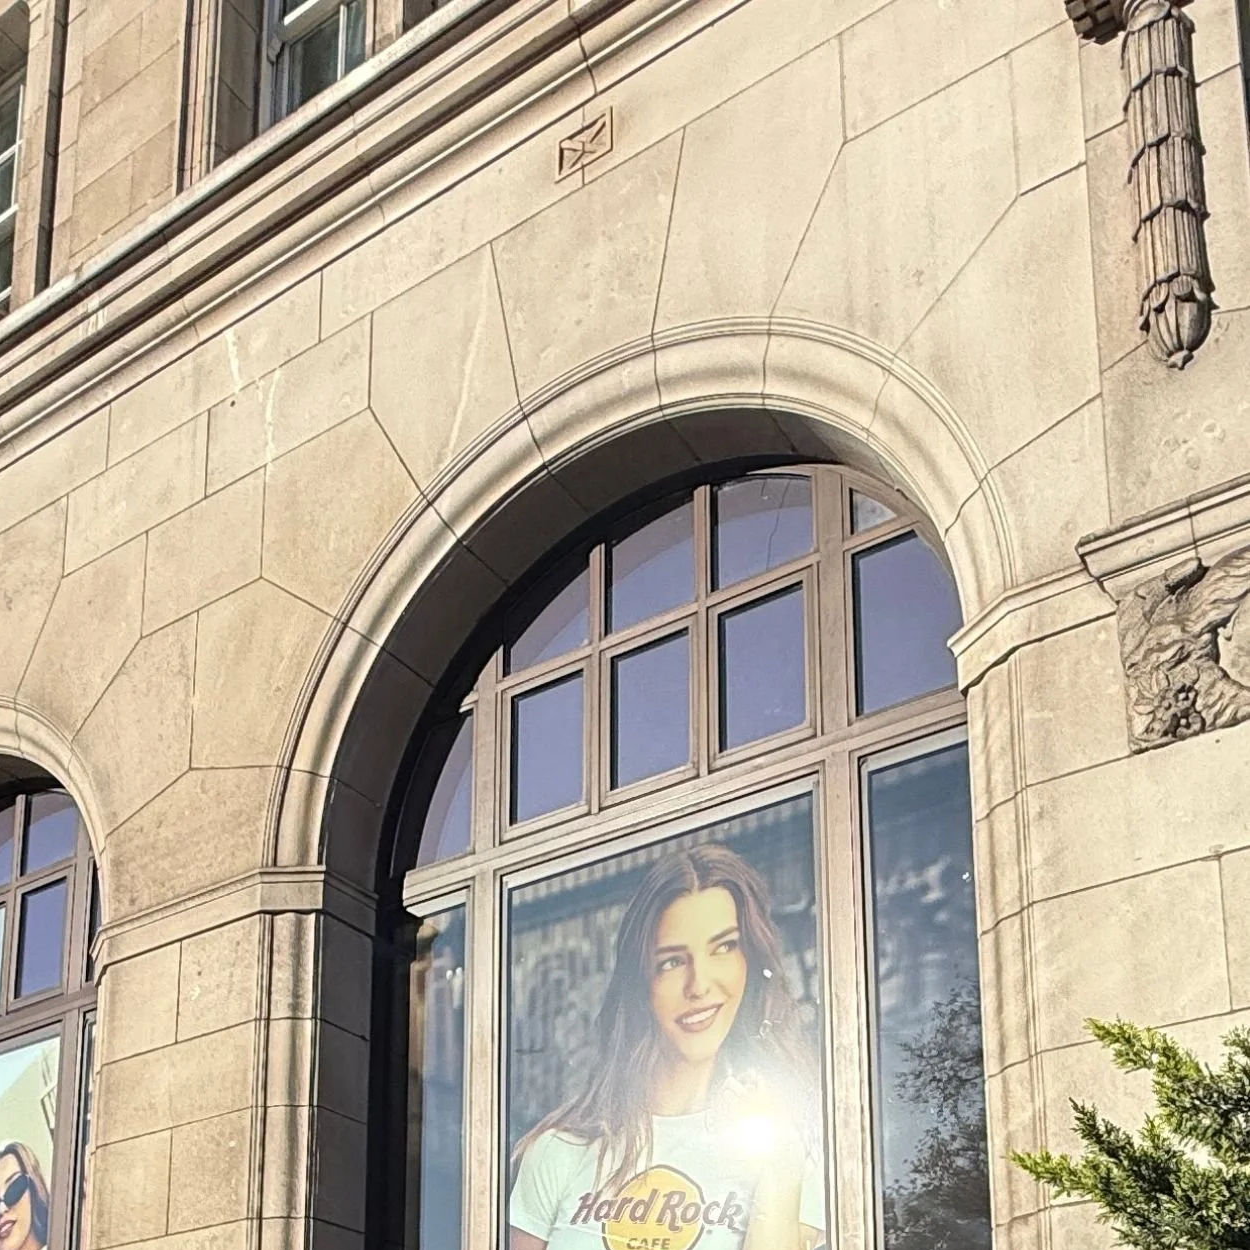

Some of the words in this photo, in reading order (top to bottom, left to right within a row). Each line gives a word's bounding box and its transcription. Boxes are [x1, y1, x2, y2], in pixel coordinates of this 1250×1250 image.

[569, 1188, 660, 1226] Hard
[655, 1190, 747, 1233] Rock
[626, 1237, 671, 1250] CAFE
